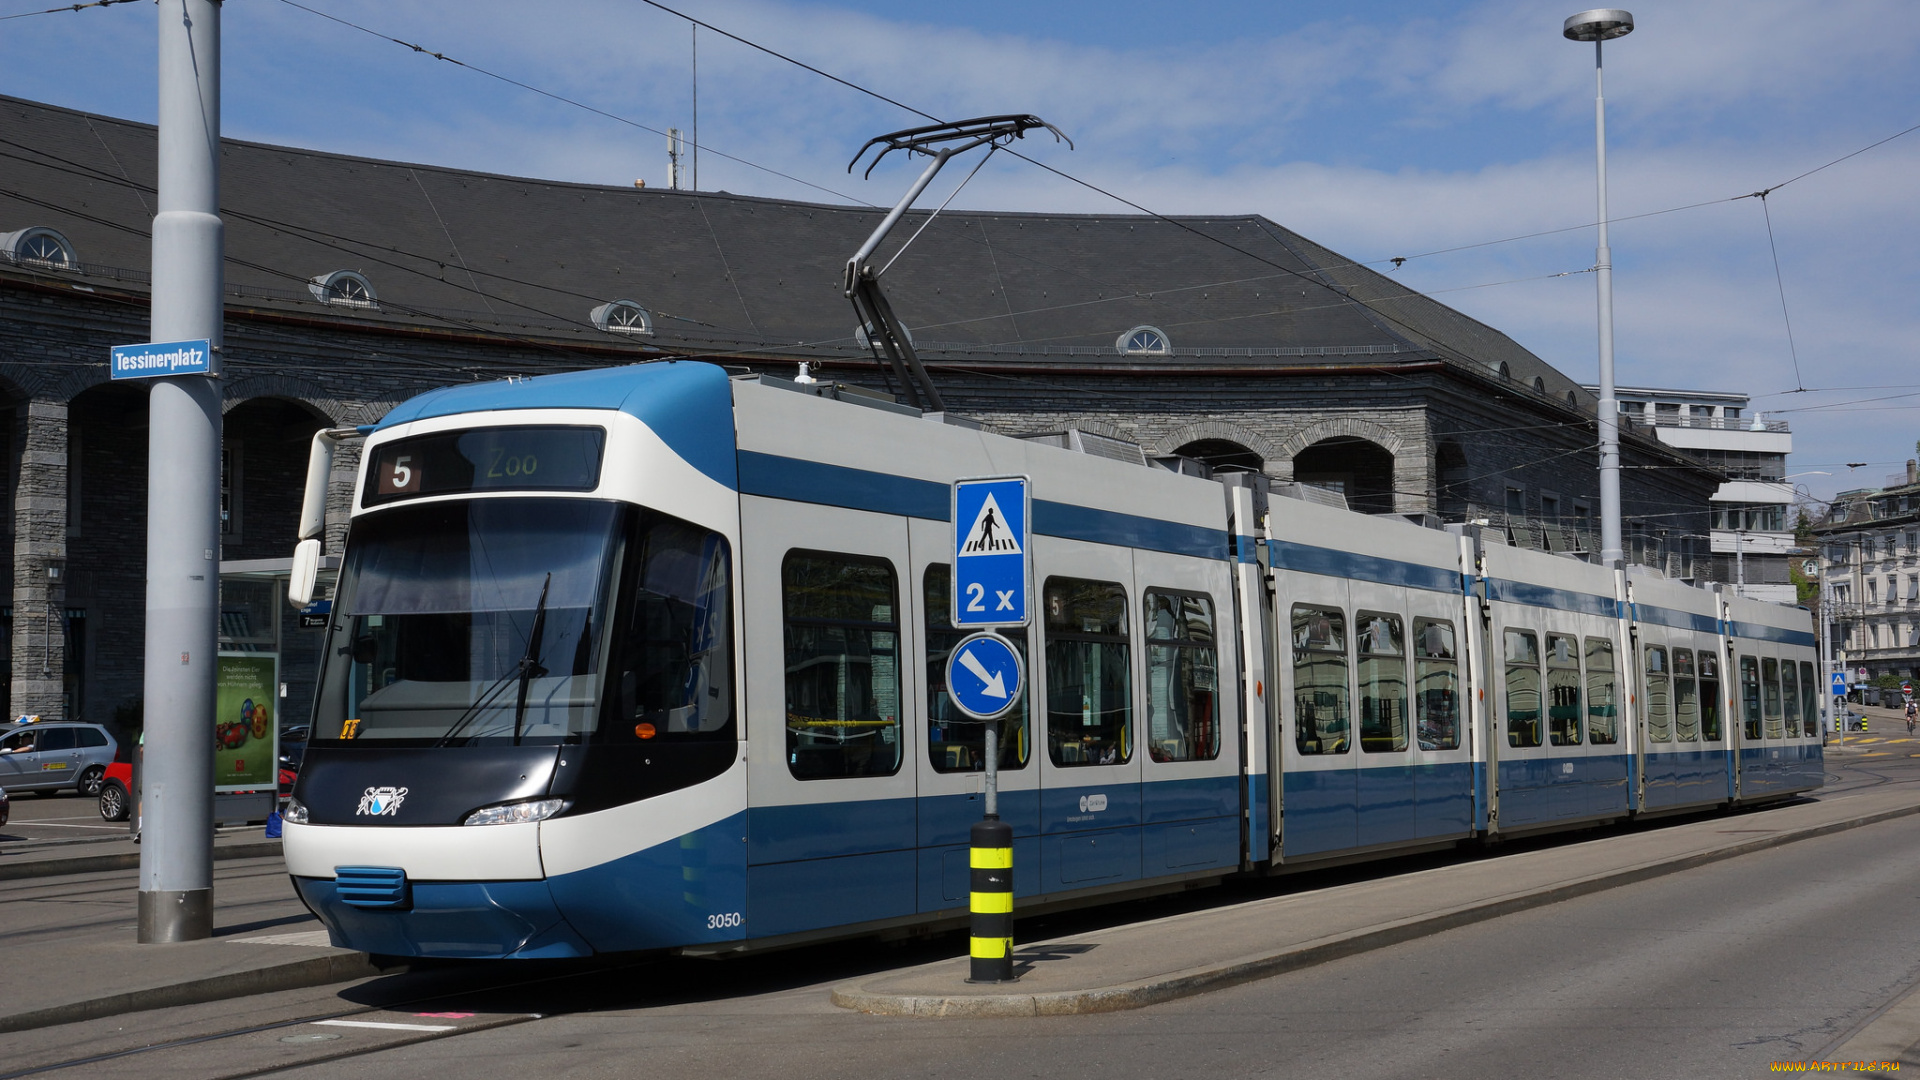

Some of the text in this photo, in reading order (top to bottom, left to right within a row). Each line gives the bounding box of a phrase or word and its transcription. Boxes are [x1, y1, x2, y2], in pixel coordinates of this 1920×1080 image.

[115, 348, 203, 371] Tessinerplatz
[392, 455, 412, 488] 5
[487, 447, 537, 478] Zoo
[966, 582, 1015, 612] 2 x
[1052, 595, 1059, 616] 5
[304, 617, 310, 626] 7
[707, 912, 741, 929] 3050
